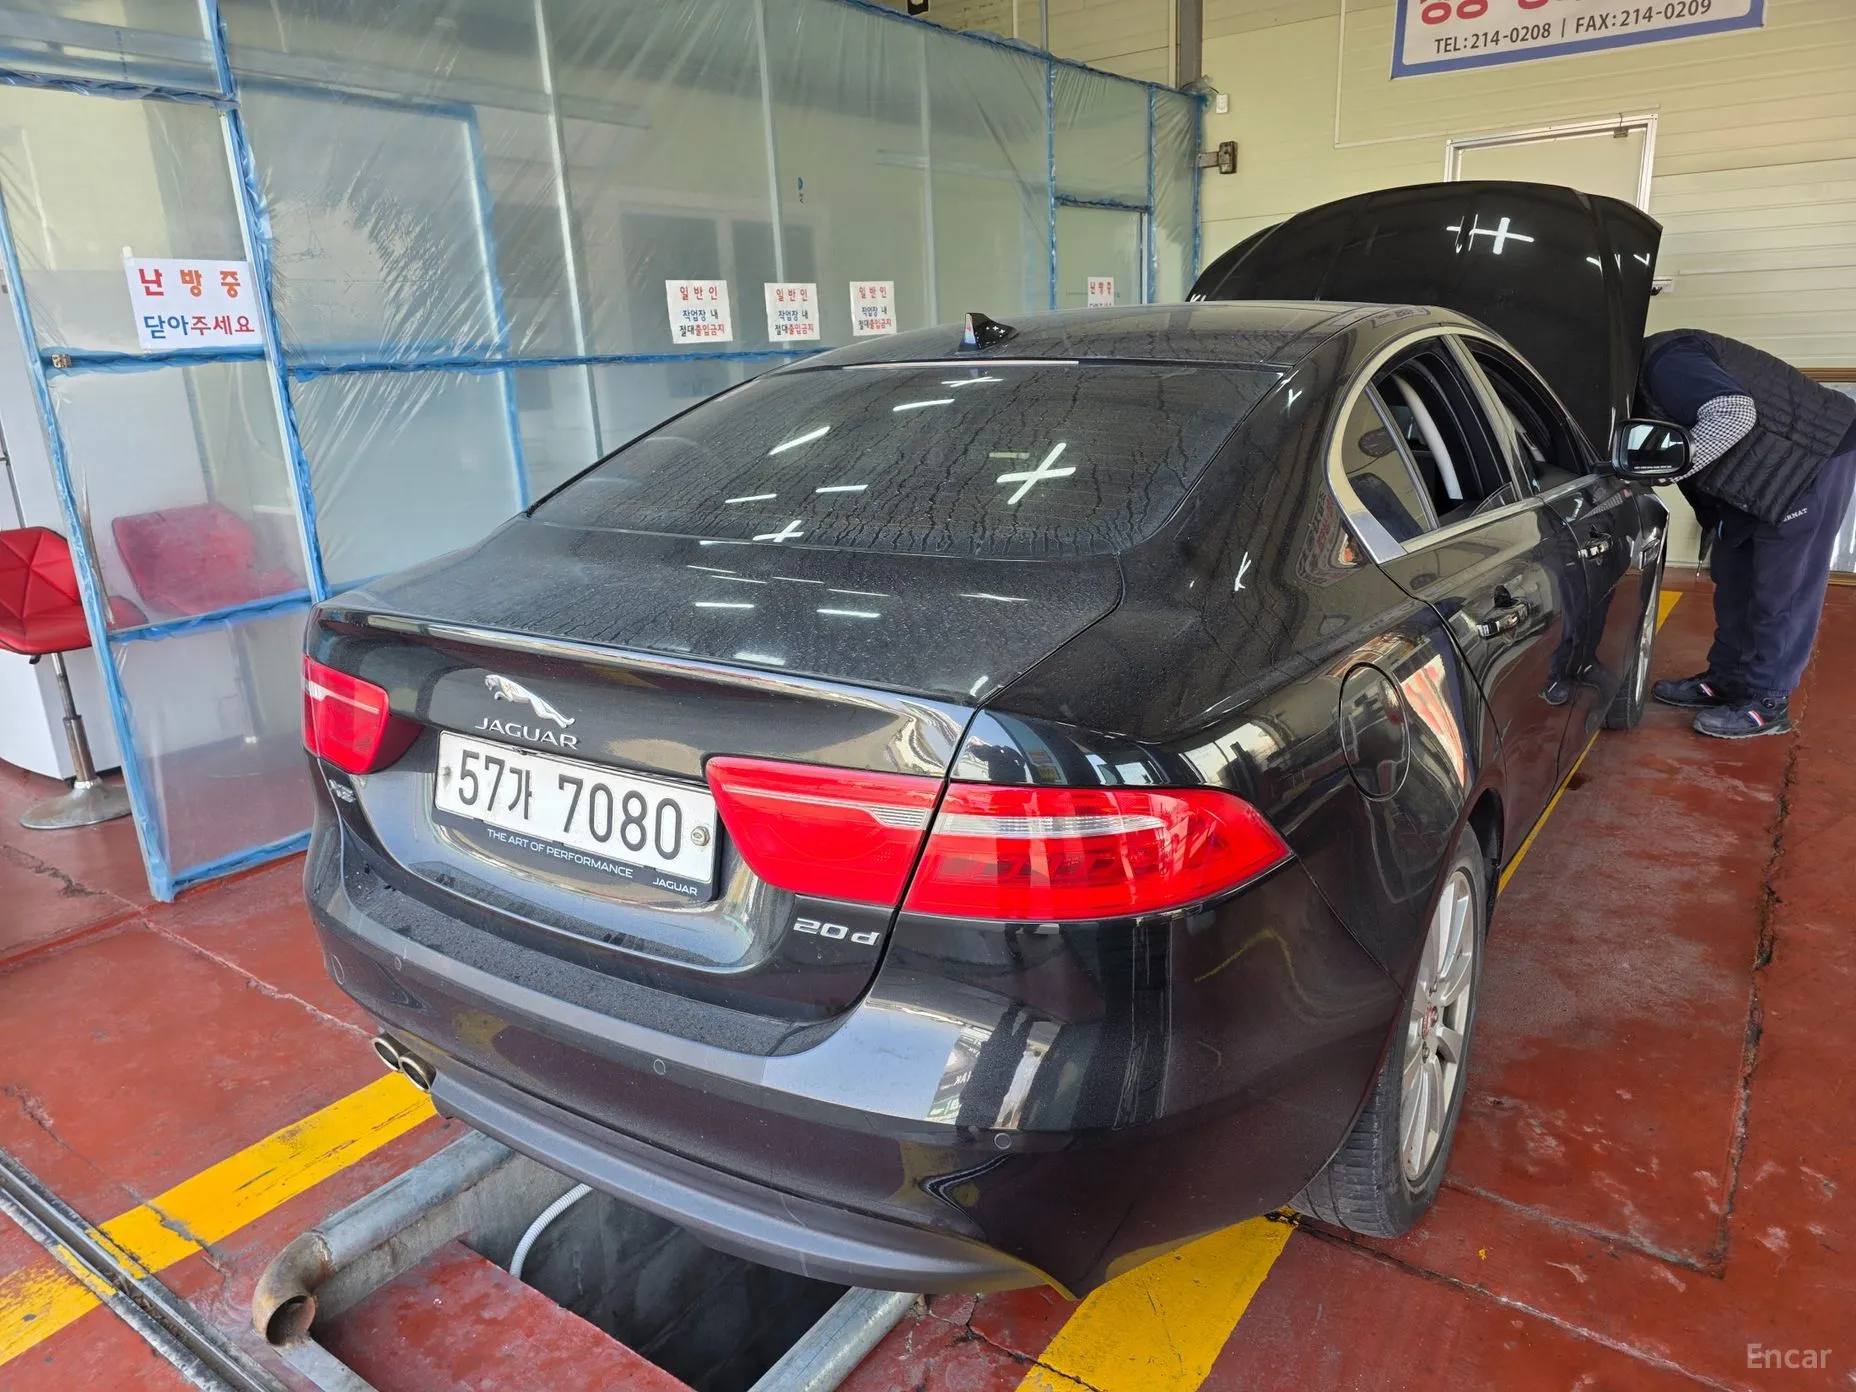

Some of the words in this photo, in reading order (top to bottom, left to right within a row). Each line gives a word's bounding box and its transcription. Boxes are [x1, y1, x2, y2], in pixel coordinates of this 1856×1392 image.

[1434, 22, 1552, 54] TEL:214-0208
[1575, 0, 1712, 34] FAX:214-0209
[143, 314, 256, 340] 닫아주세요
[682, 309, 707, 322] 작업장
[474, 717, 579, 750] JAGUAR
[458, 749, 533, 821] 57가
[558, 773, 683, 861] 7080
[487, 828, 507, 843] THE
[508, 835, 530, 849] ART
[530, 841, 546, 853] OF
[546, 846, 634, 879] PERFORMANCE
[652, 876, 699, 897] JAGUAR
